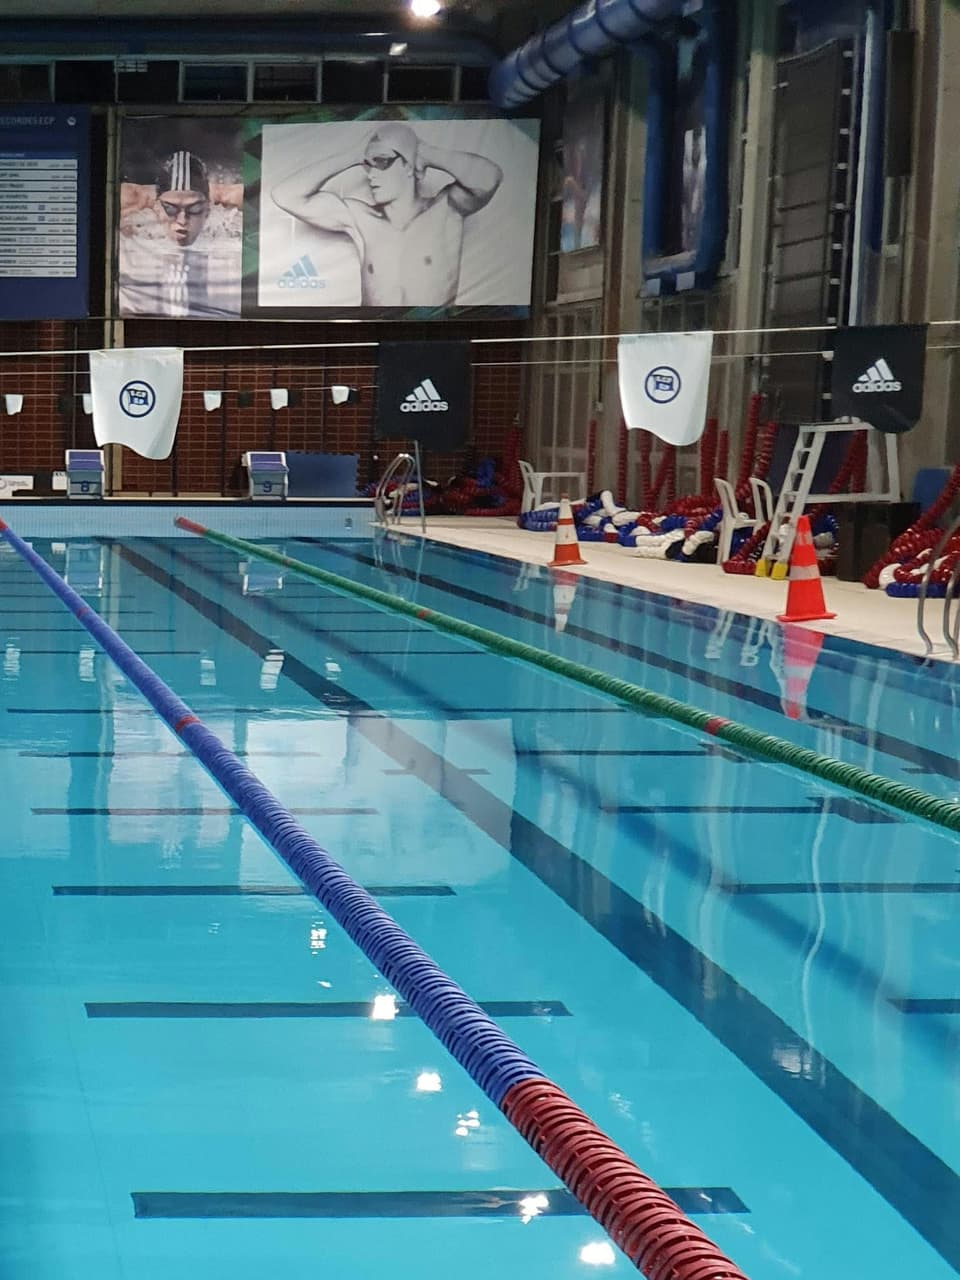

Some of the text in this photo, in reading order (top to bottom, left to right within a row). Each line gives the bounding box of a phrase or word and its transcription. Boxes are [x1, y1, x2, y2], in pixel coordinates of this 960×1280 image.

[278, 275, 326, 288] adidas
[852, 379, 902, 393] adidas
[400, 399, 449, 412] adidas
[80, 480, 90, 492] 8
[263, 480, 273, 492] 9
